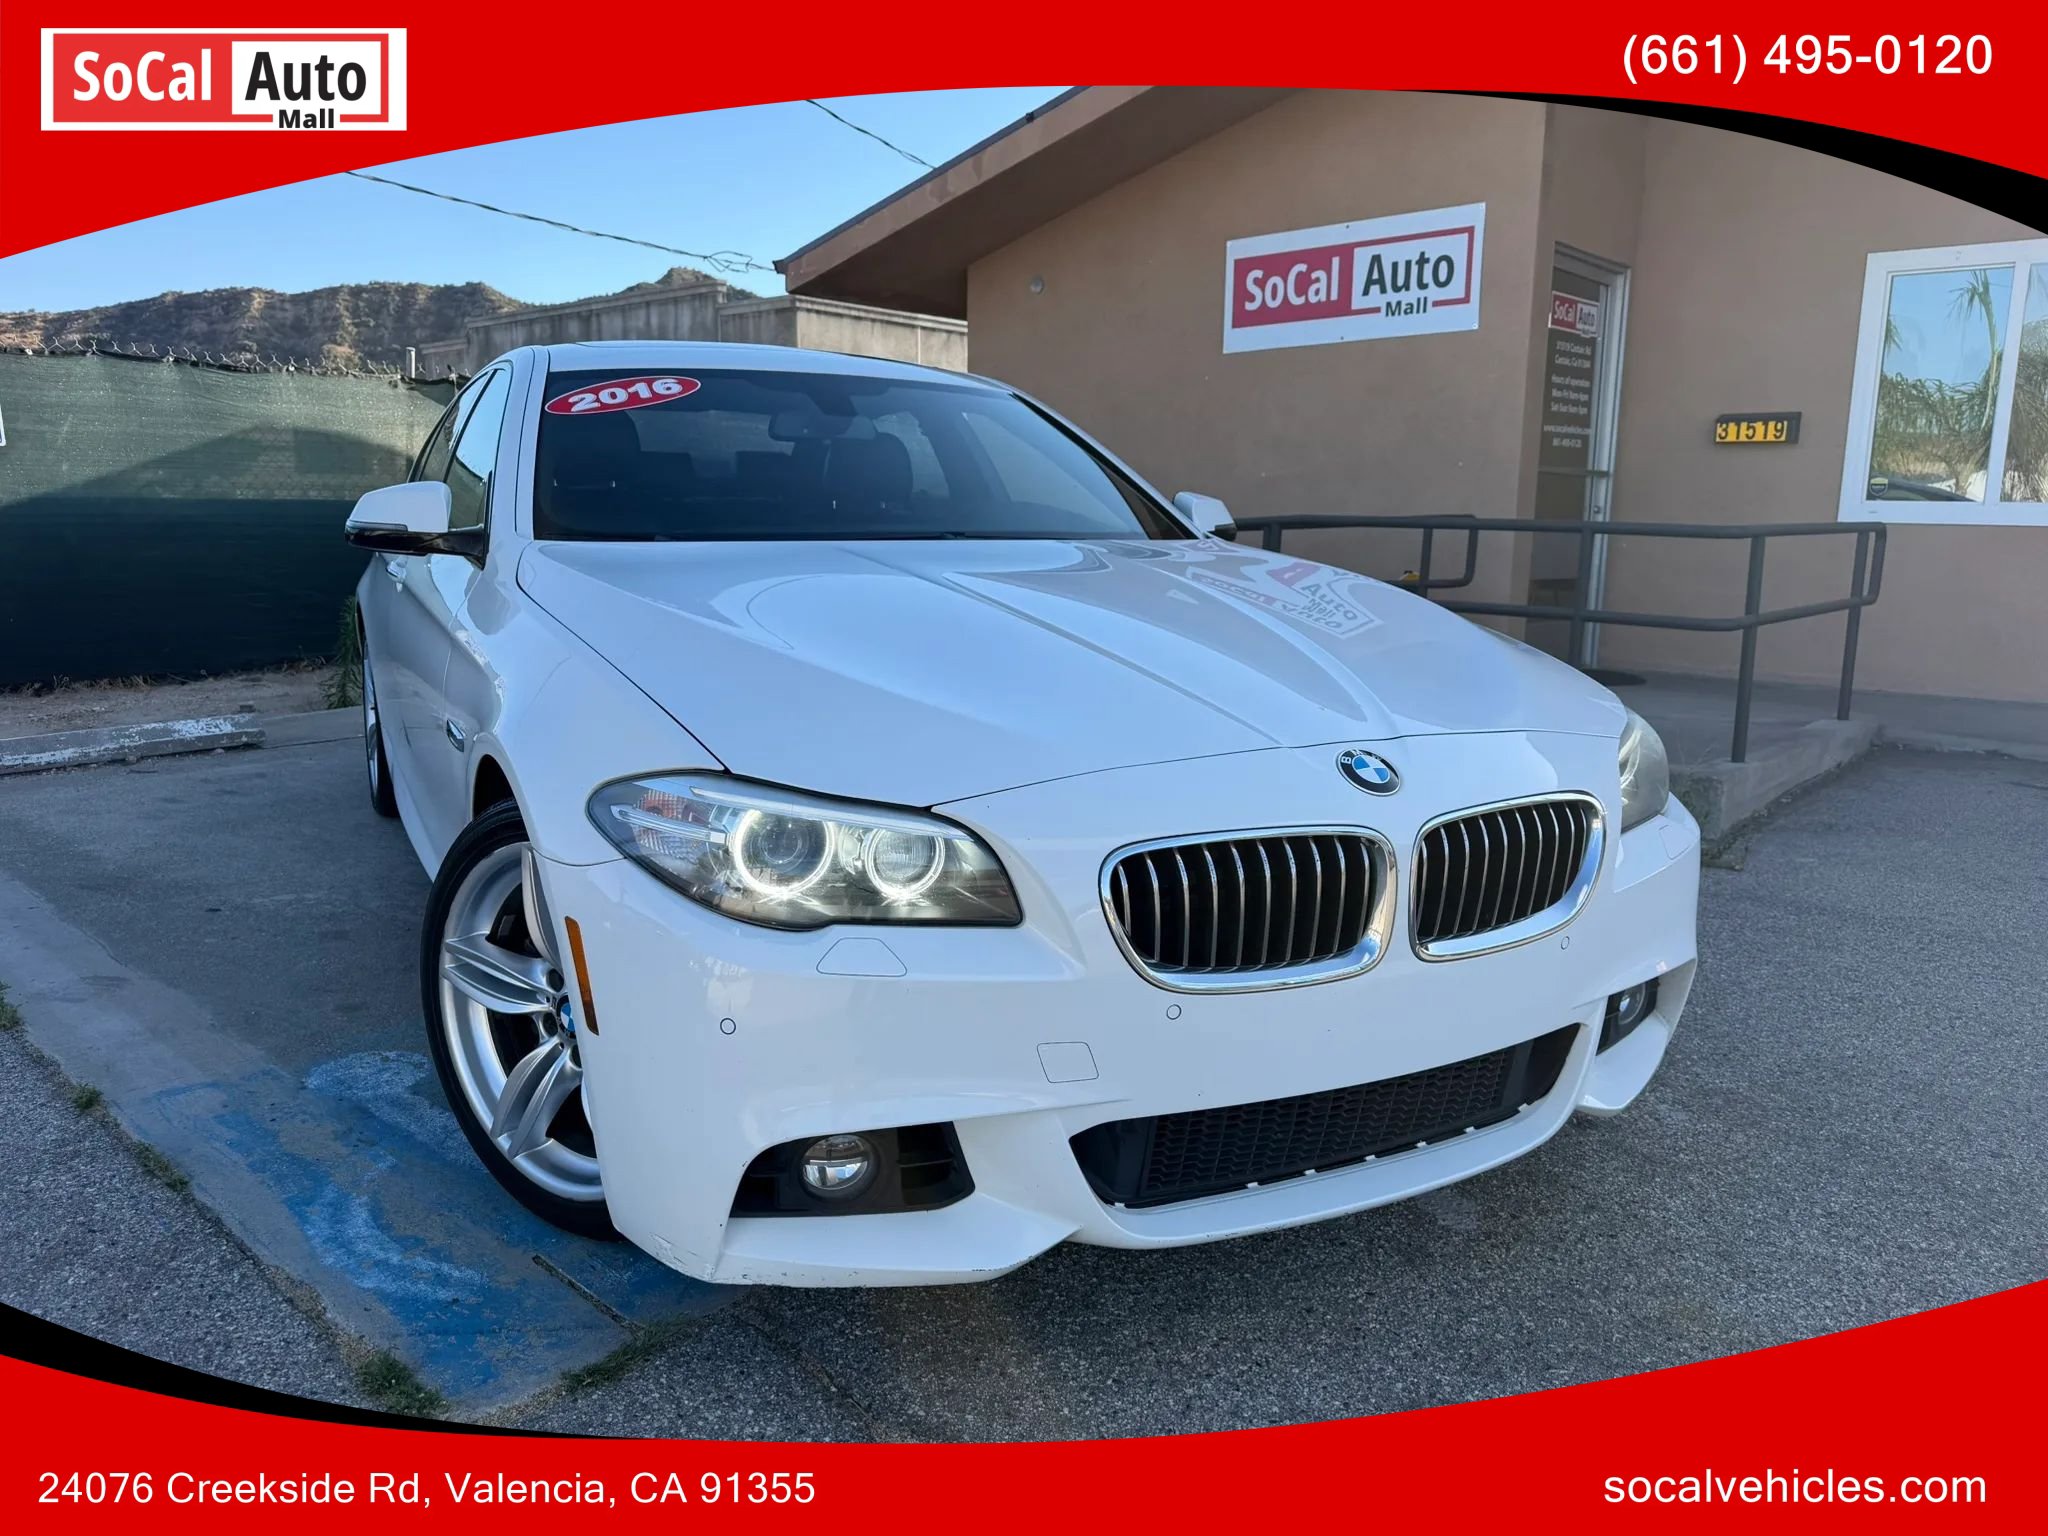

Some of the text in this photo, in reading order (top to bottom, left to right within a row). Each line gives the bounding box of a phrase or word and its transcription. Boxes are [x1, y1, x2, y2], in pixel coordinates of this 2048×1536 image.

[1244, 251, 1455, 311] SoCal Auto
[1385, 296, 1428, 317] Mall
[1553, 300, 1596, 328] SoCal Auto
[568, 379, 683, 412] 2016
[1718, 420, 1785, 440] 31519
